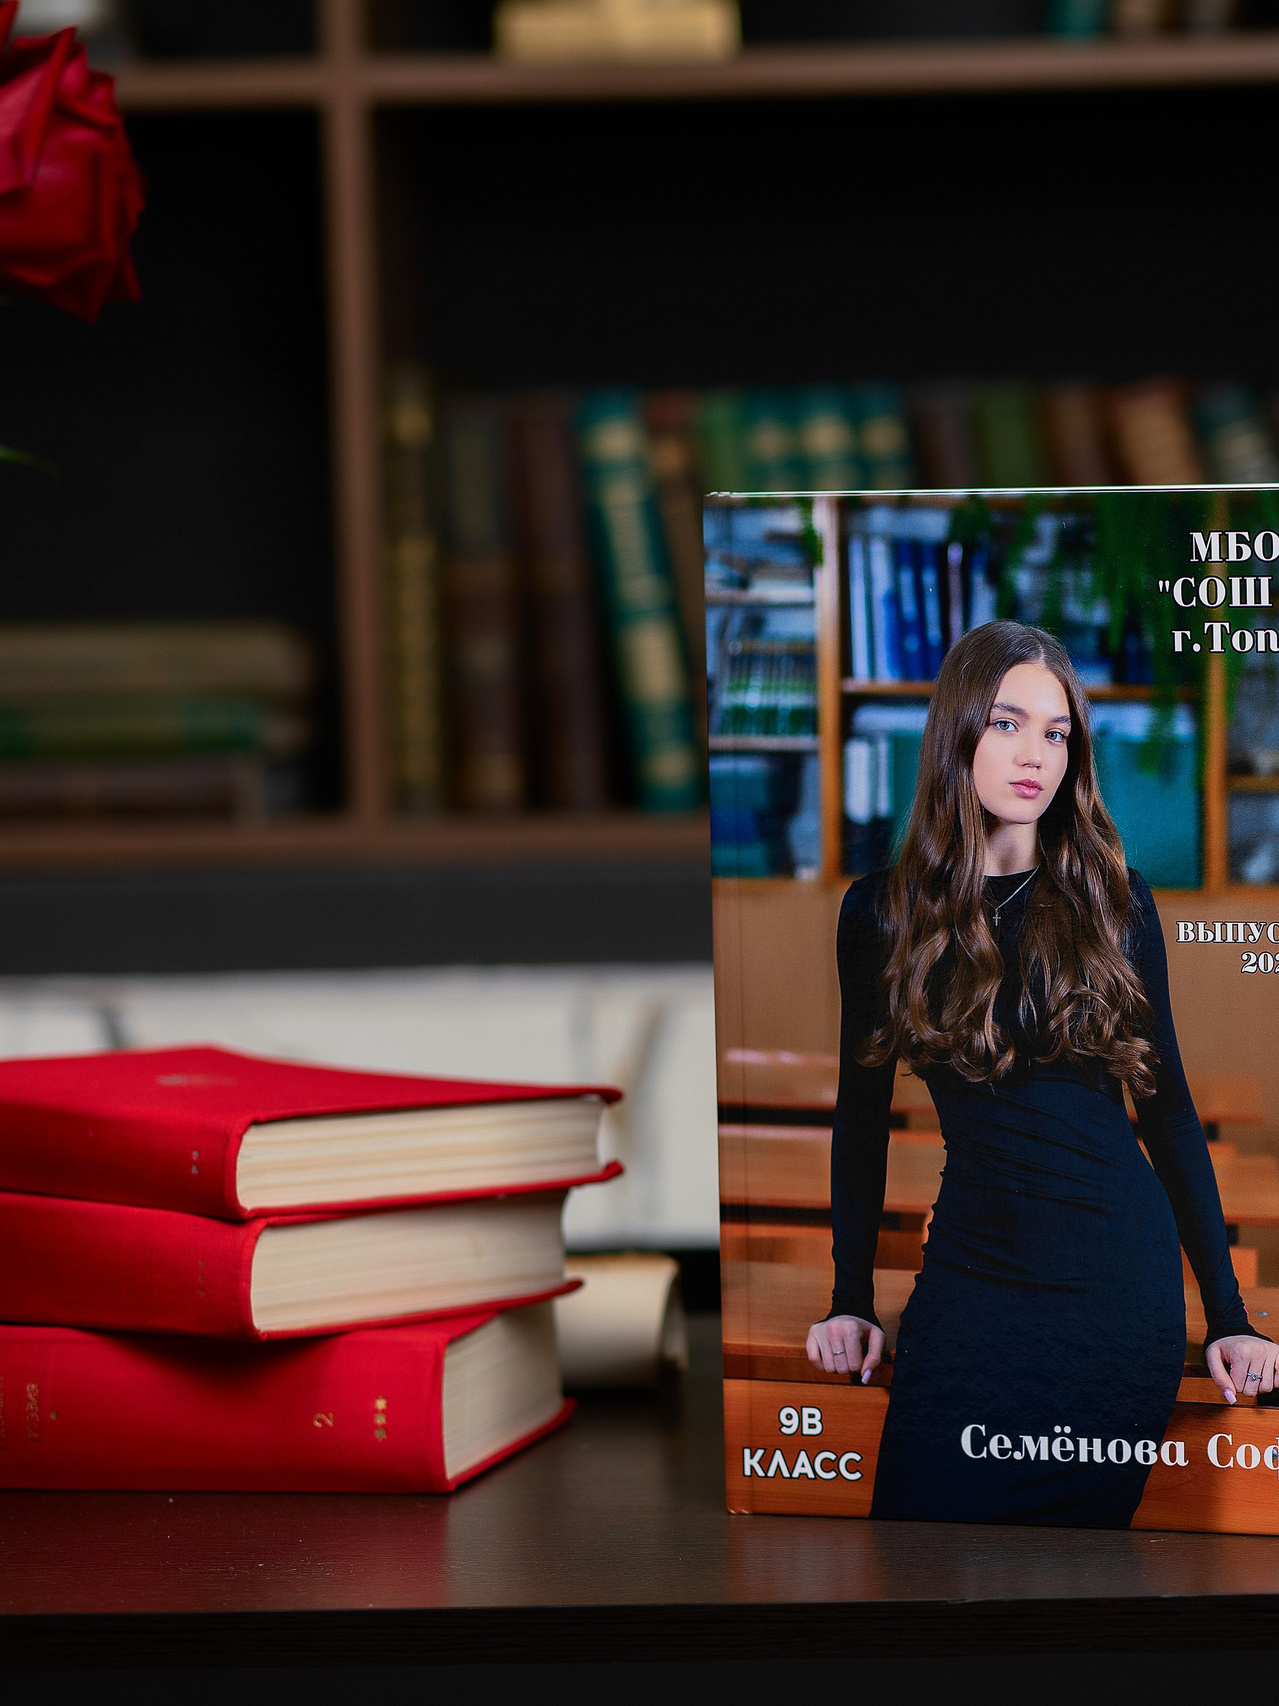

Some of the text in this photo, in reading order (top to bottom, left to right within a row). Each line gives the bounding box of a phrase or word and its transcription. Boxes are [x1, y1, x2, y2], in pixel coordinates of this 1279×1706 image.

[1158, 576, 1273, 607] "СОШ
[313, 1411, 334, 1428] 2
[779, 1407, 822, 1435] 9В
[961, 1424, 1189, 1467] Семёнова
[743, 1448, 862, 1480] КЛАСС
